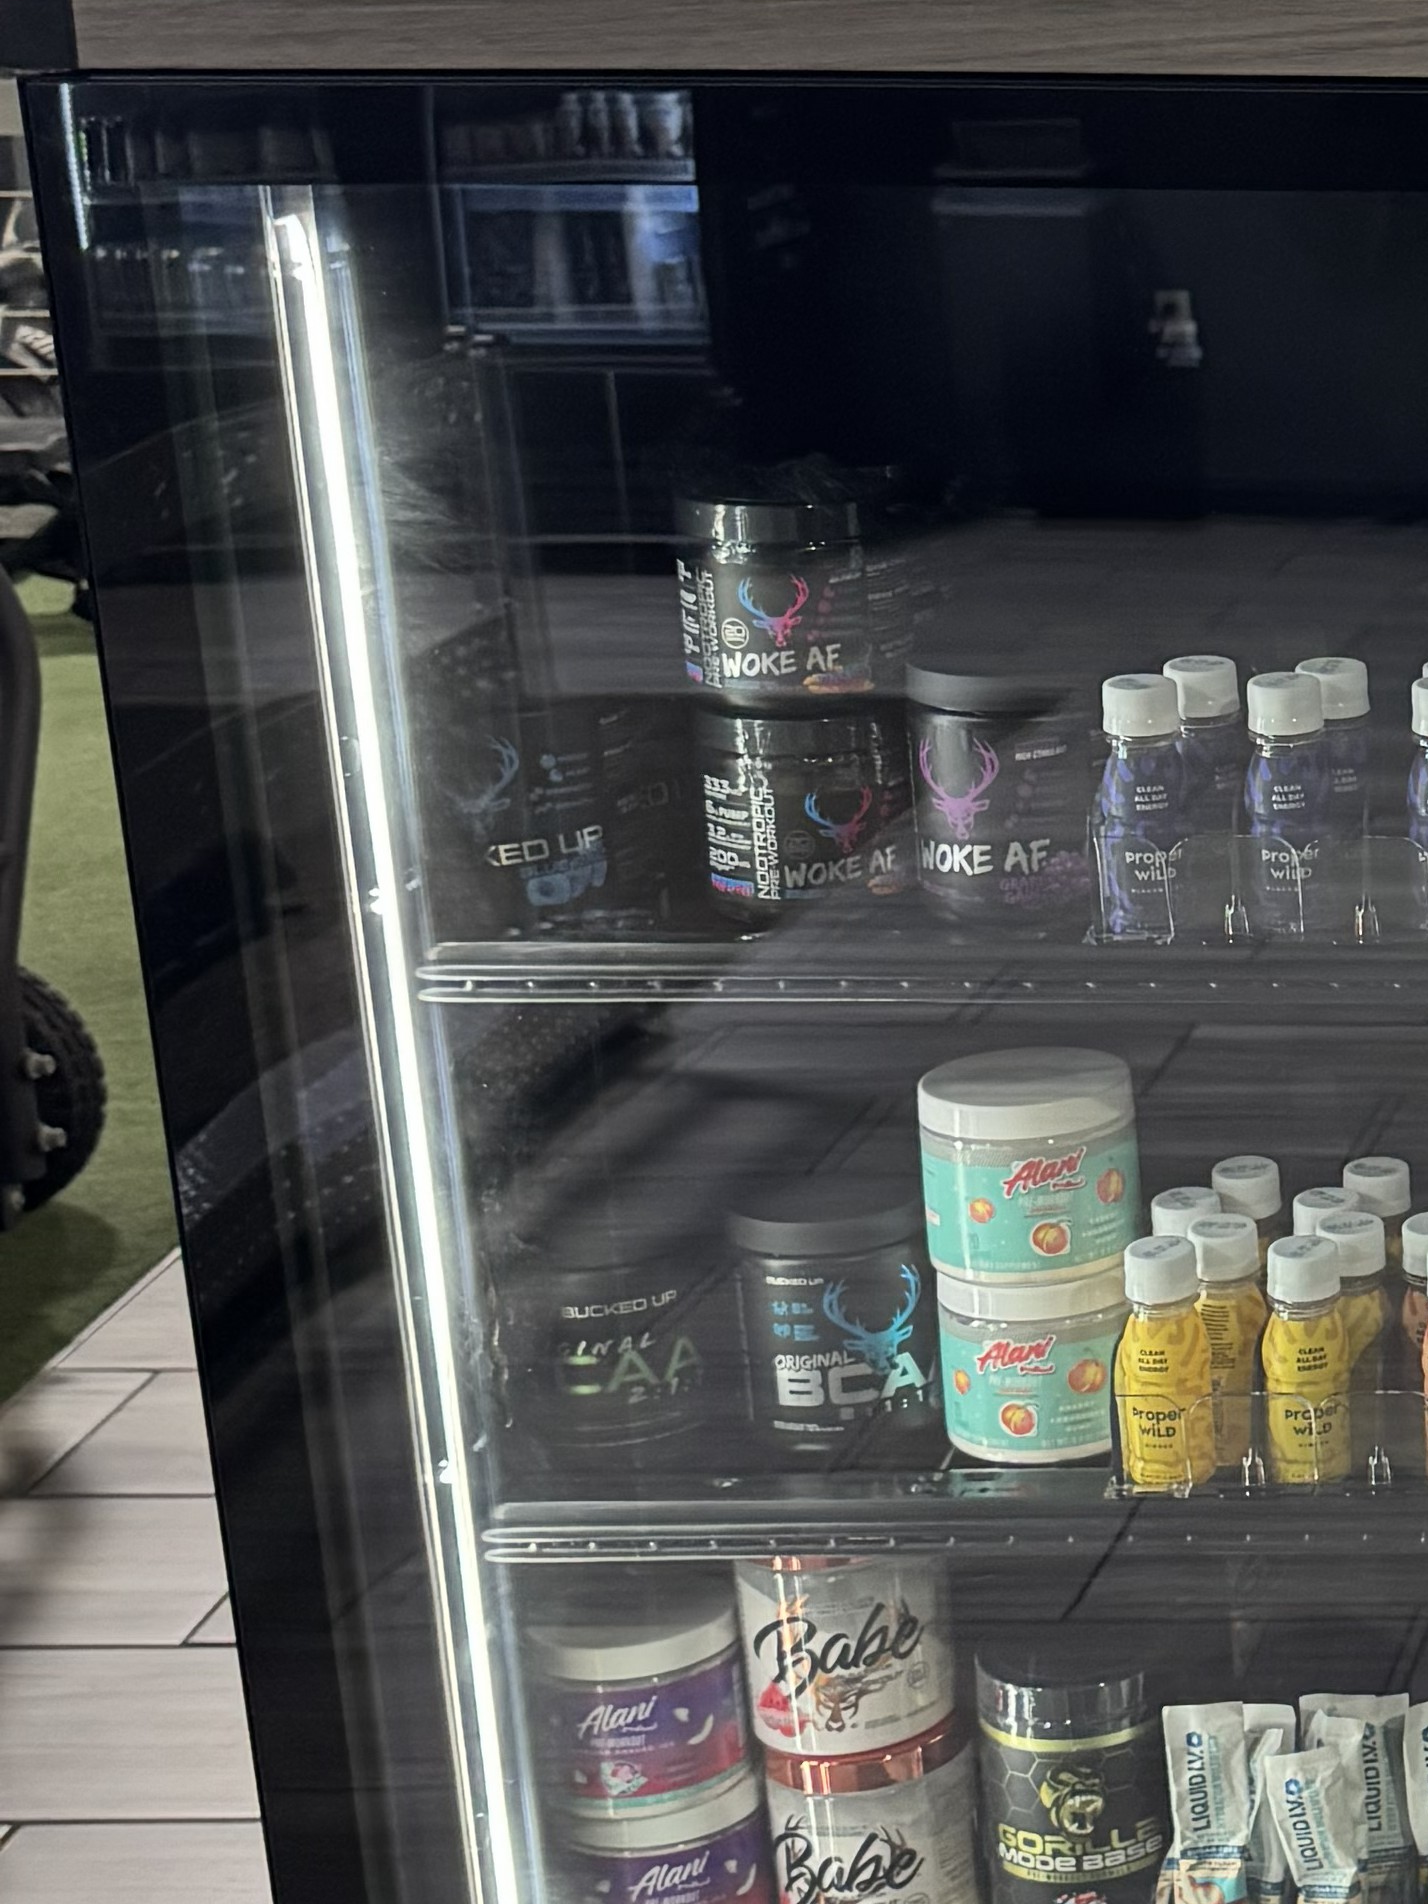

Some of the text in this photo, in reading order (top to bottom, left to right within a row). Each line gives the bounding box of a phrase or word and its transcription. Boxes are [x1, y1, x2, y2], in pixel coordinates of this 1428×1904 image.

[721, 643, 842, 679] WOKE AF
[558, 825, 603, 854] UP
[920, 837, 1051, 877] WOKE AF
[784, 853, 863, 889] WOKE
[562, 1289, 678, 1319] BUCKED UP
[773, 1349, 857, 1373] ORIGINAL
[753, 1602, 925, 1699] Babe
[577, 1695, 658, 1740] Alani
[1188, 1772, 1212, 1832] LIQUID
[1364, 1769, 1383, 1833] LIQUID
[1292, 1818, 1325, 1872] LIQUID
[627, 1850, 710, 1903] Alani
